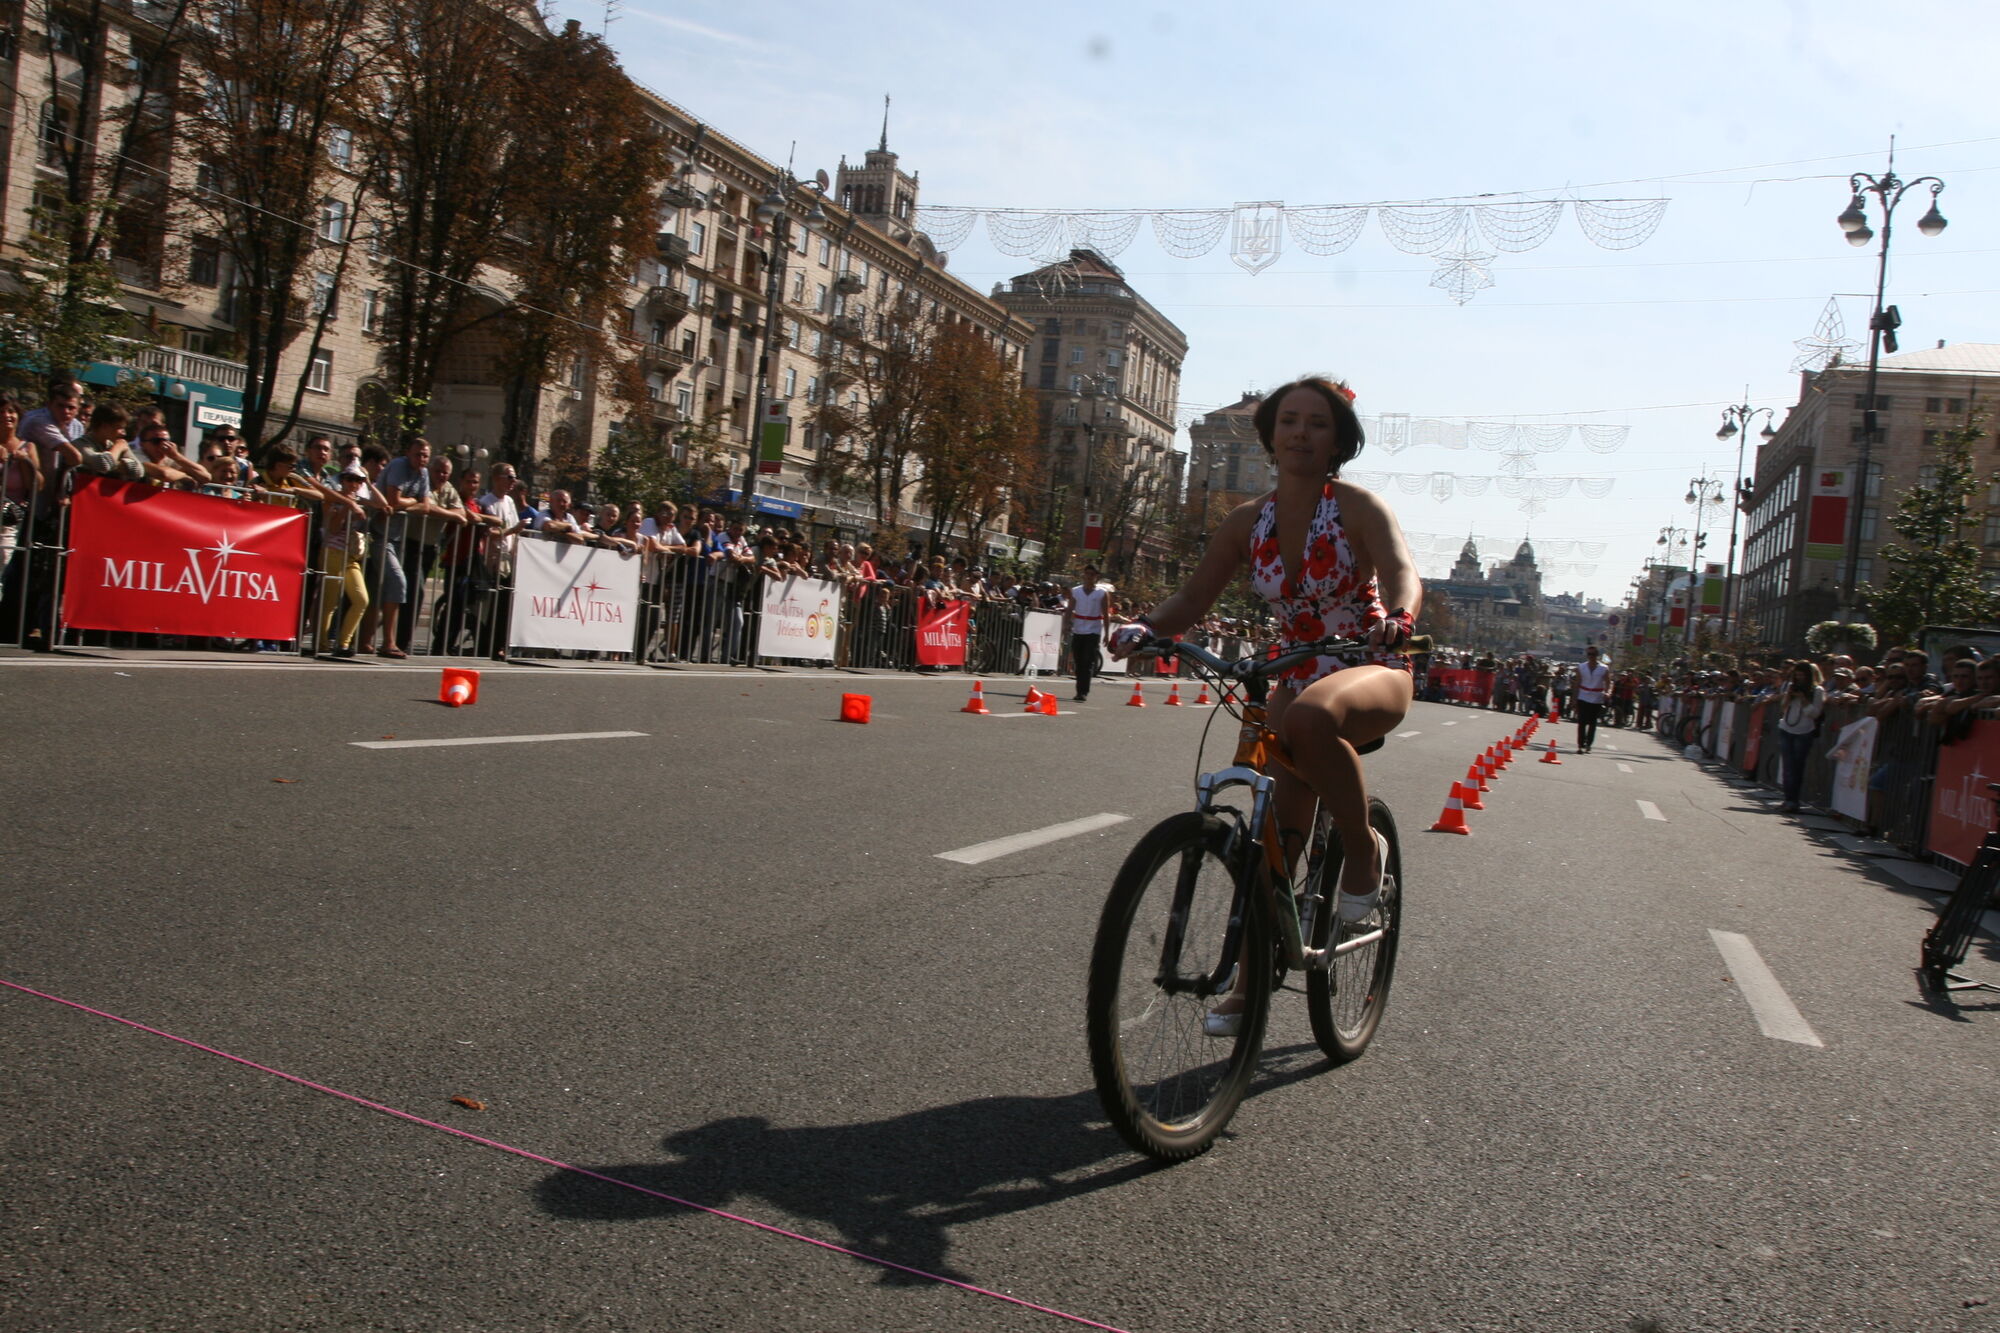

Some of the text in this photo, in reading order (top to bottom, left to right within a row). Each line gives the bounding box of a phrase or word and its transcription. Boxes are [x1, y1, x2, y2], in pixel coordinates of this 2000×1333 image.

[101, 547, 281, 605] MILAVITSA
[530, 585, 623, 626] MILAVITSA
[924, 623, 962, 650] MILAVITSA
